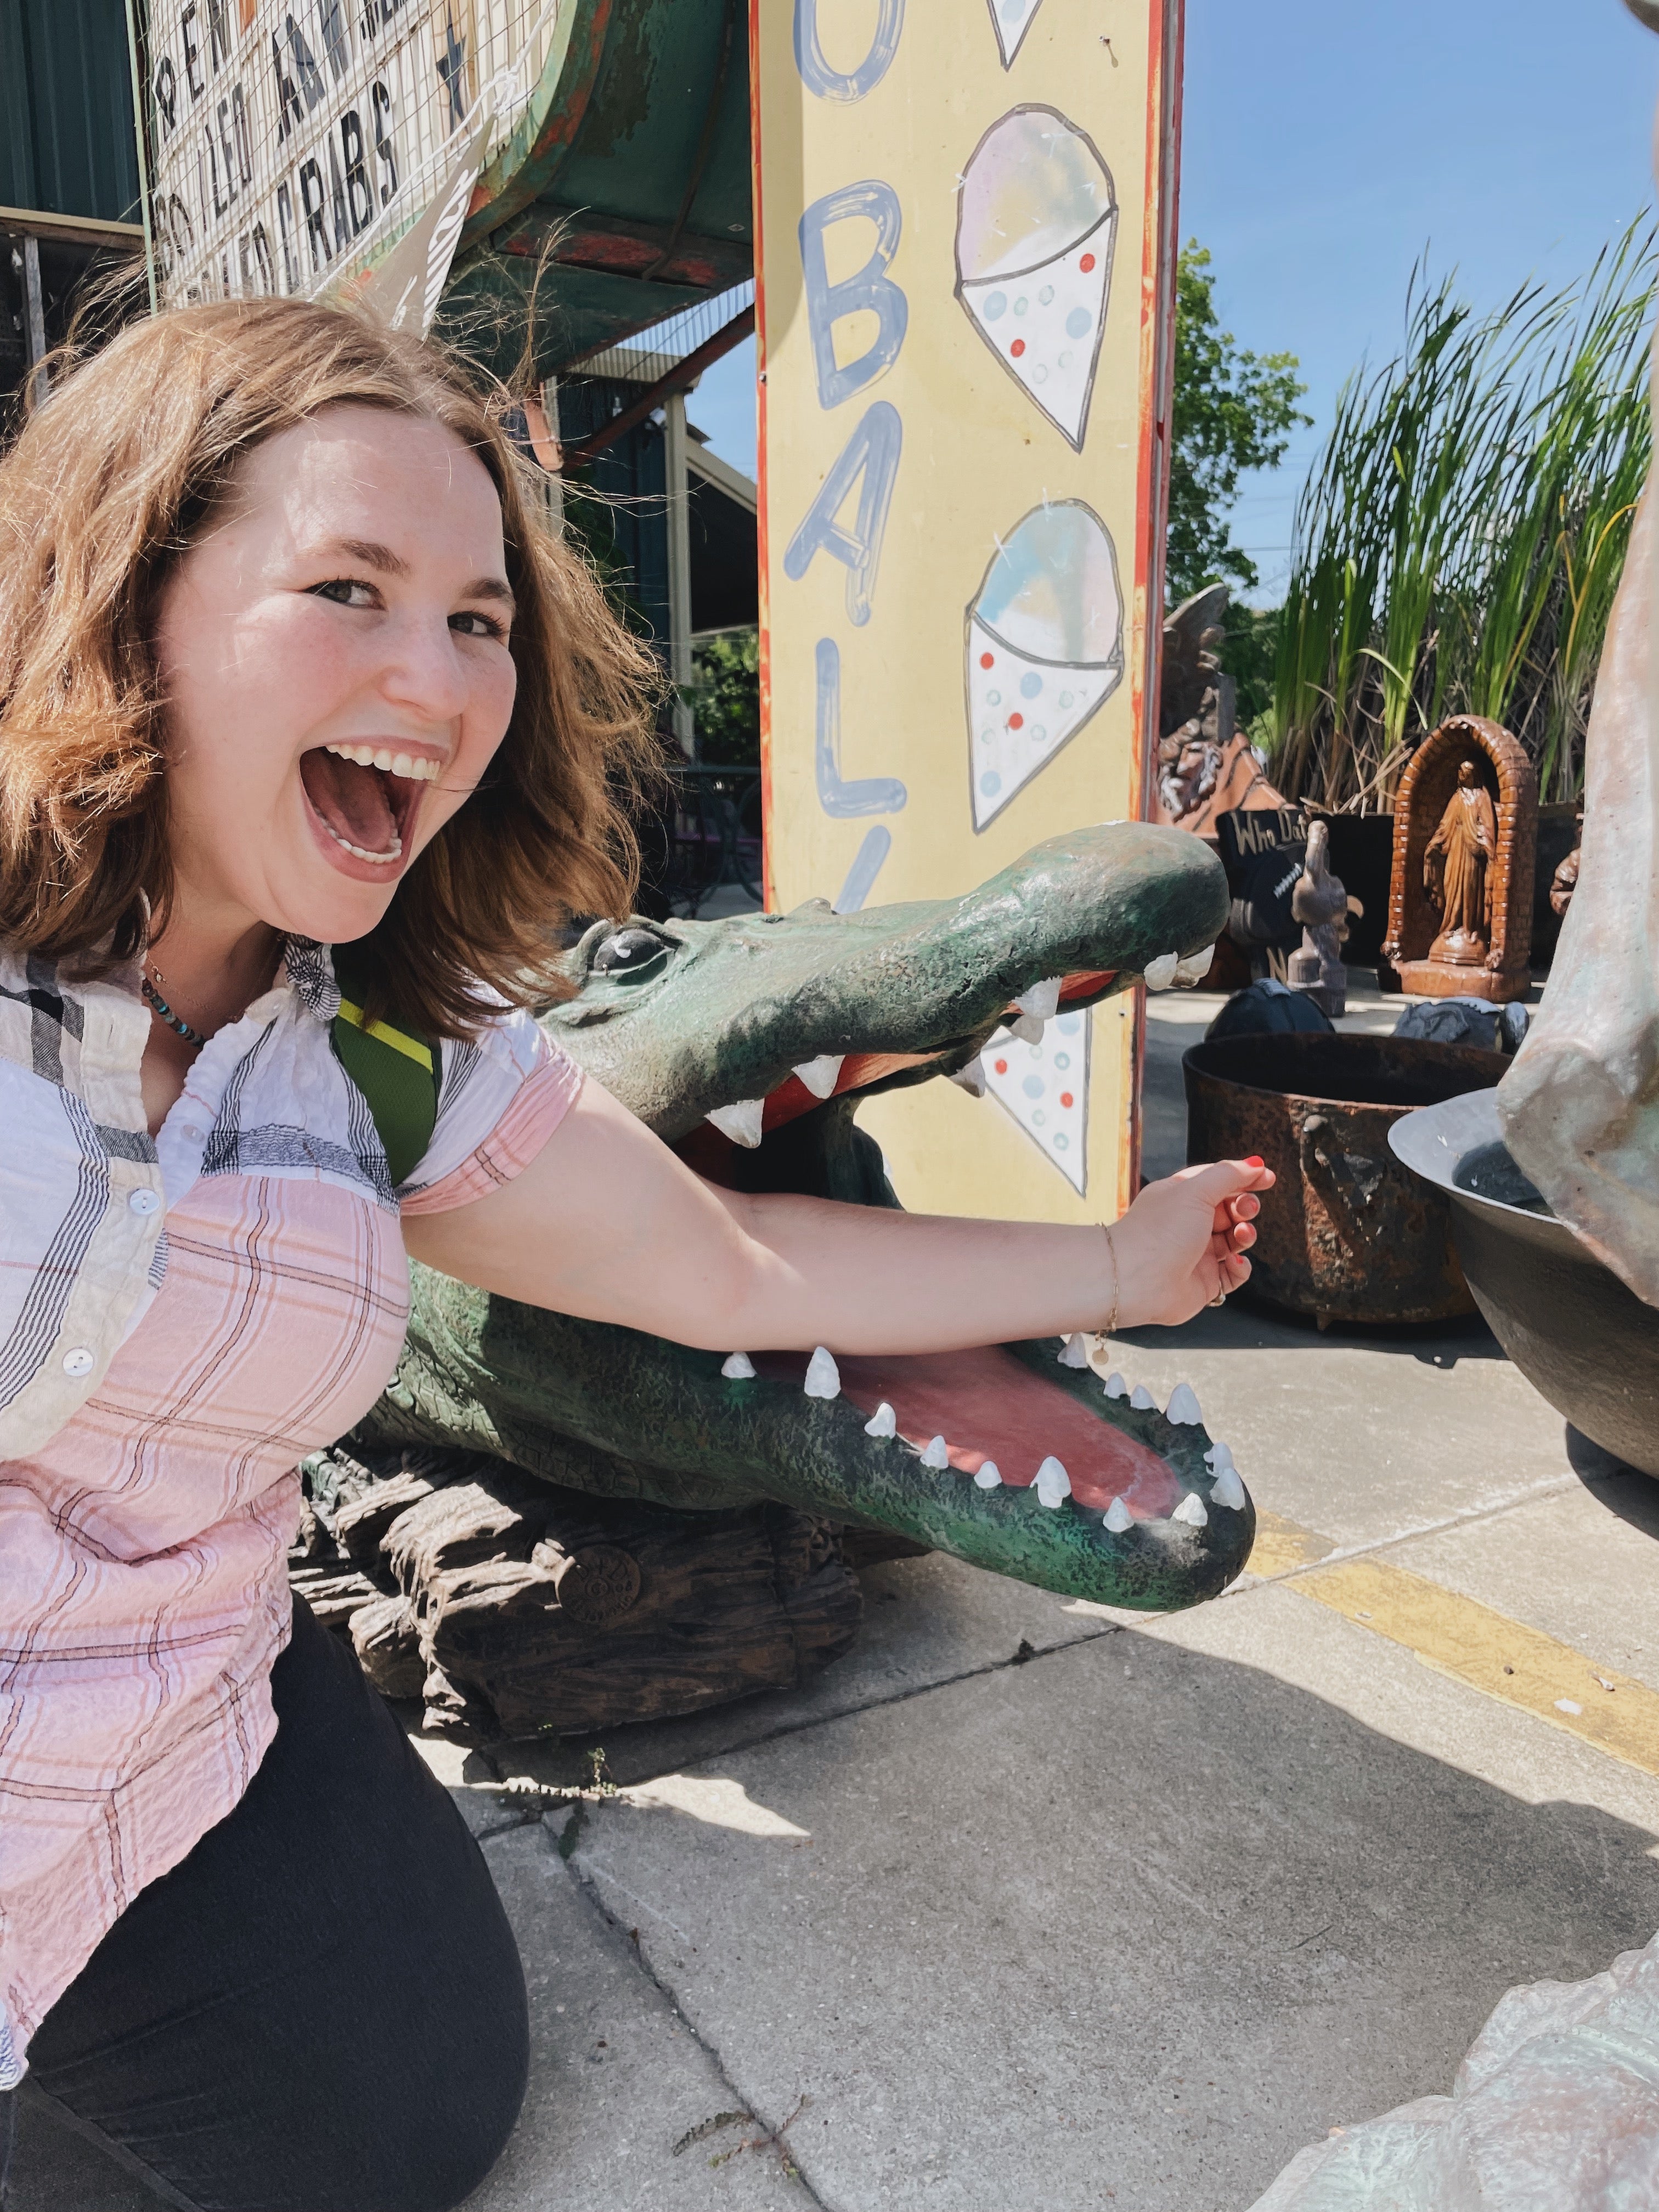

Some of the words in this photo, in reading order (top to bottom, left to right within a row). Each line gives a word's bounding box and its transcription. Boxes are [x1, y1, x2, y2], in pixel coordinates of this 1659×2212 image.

[278, 81, 399, 294] CRABS
[1229, 811, 1276, 857] Who
[1277, 809, 1308, 843] Dat
